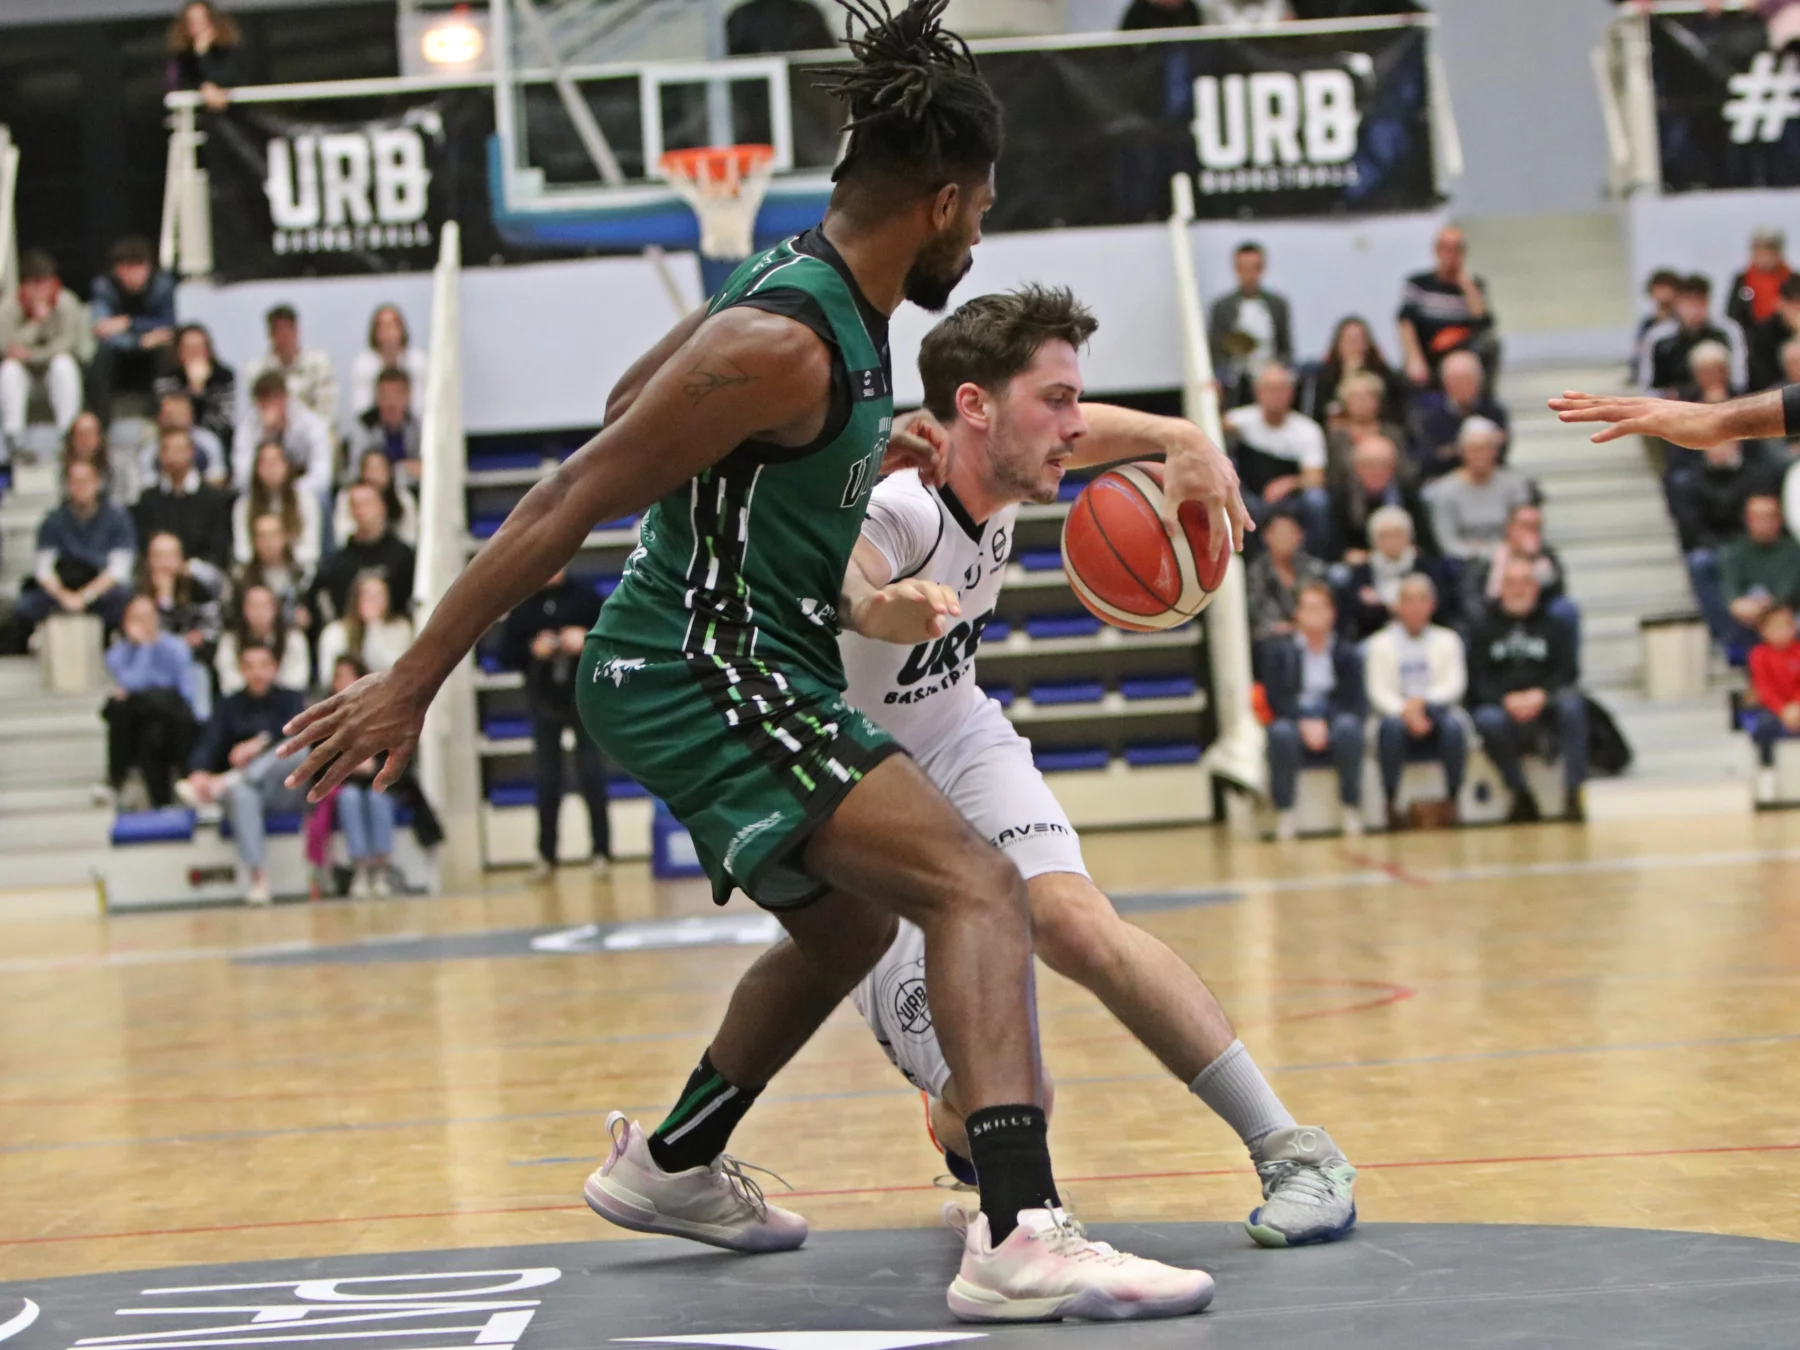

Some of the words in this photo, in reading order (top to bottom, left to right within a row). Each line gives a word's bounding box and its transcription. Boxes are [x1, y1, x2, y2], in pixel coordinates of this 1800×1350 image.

[1192, 68, 1359, 169] URB
[264, 129, 432, 230] URB
[272, 222, 433, 255] BASKETBALL
[973, 1115, 1032, 1137] SKILLS
